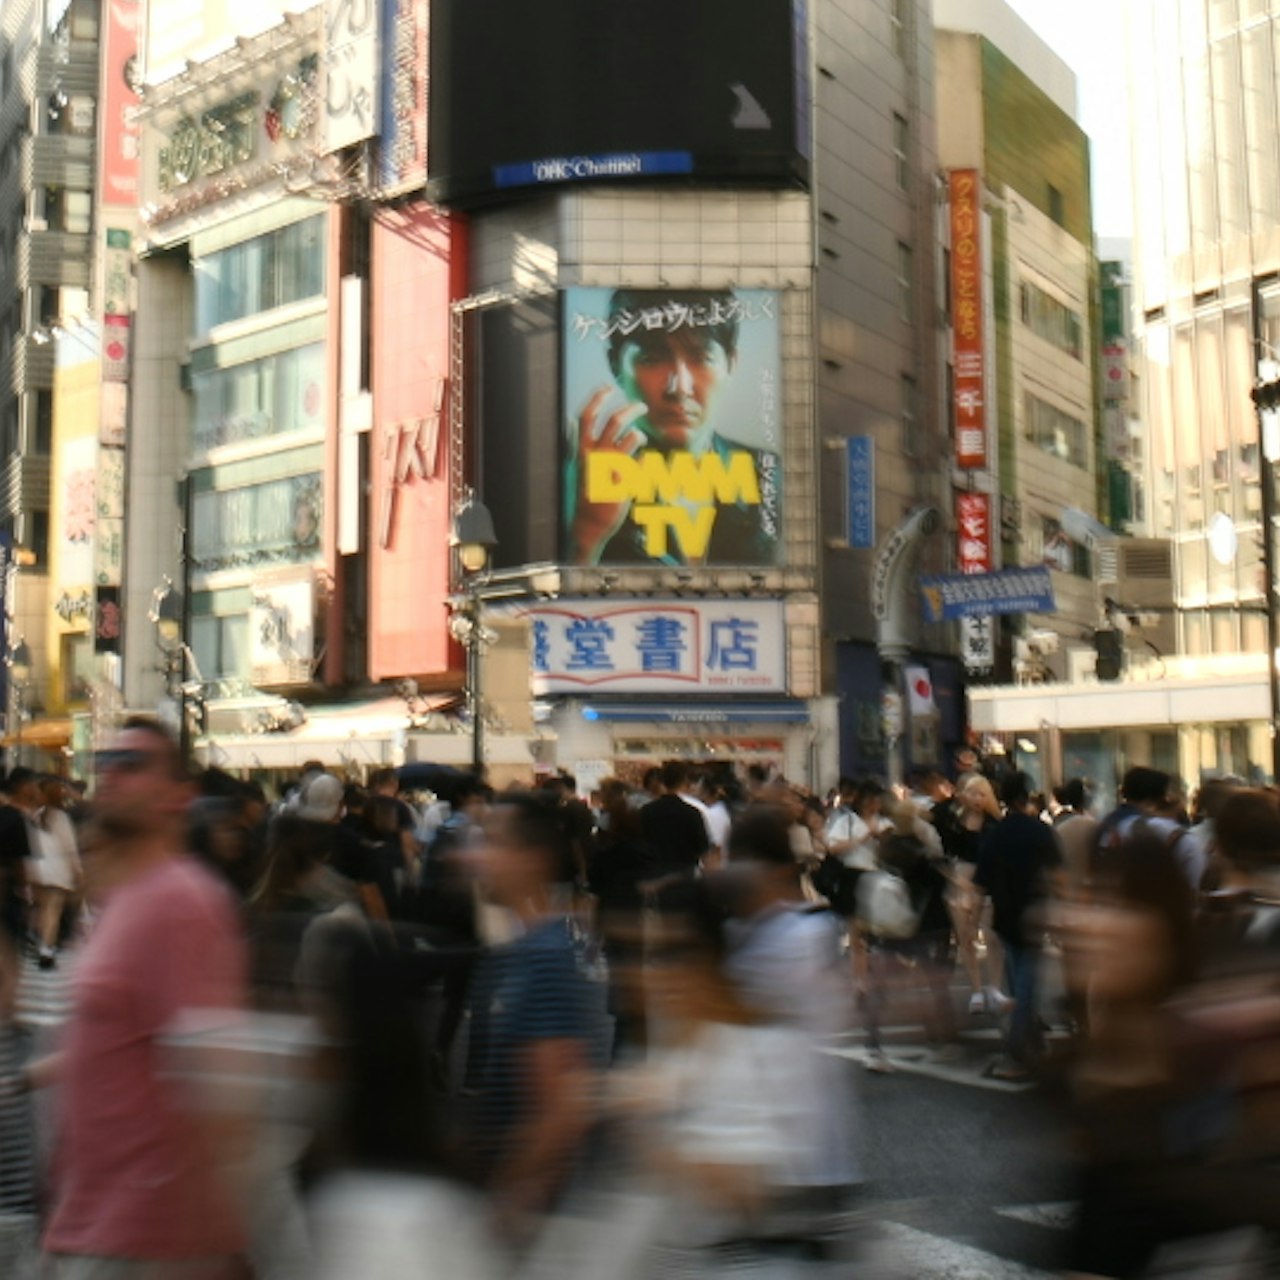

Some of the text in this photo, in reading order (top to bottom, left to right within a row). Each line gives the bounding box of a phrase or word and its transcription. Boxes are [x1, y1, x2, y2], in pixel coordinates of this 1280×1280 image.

[572, 296, 774, 344] ケンシロウによろしく
[585, 449, 761, 504] DMM
[634, 505, 717, 557] TV
